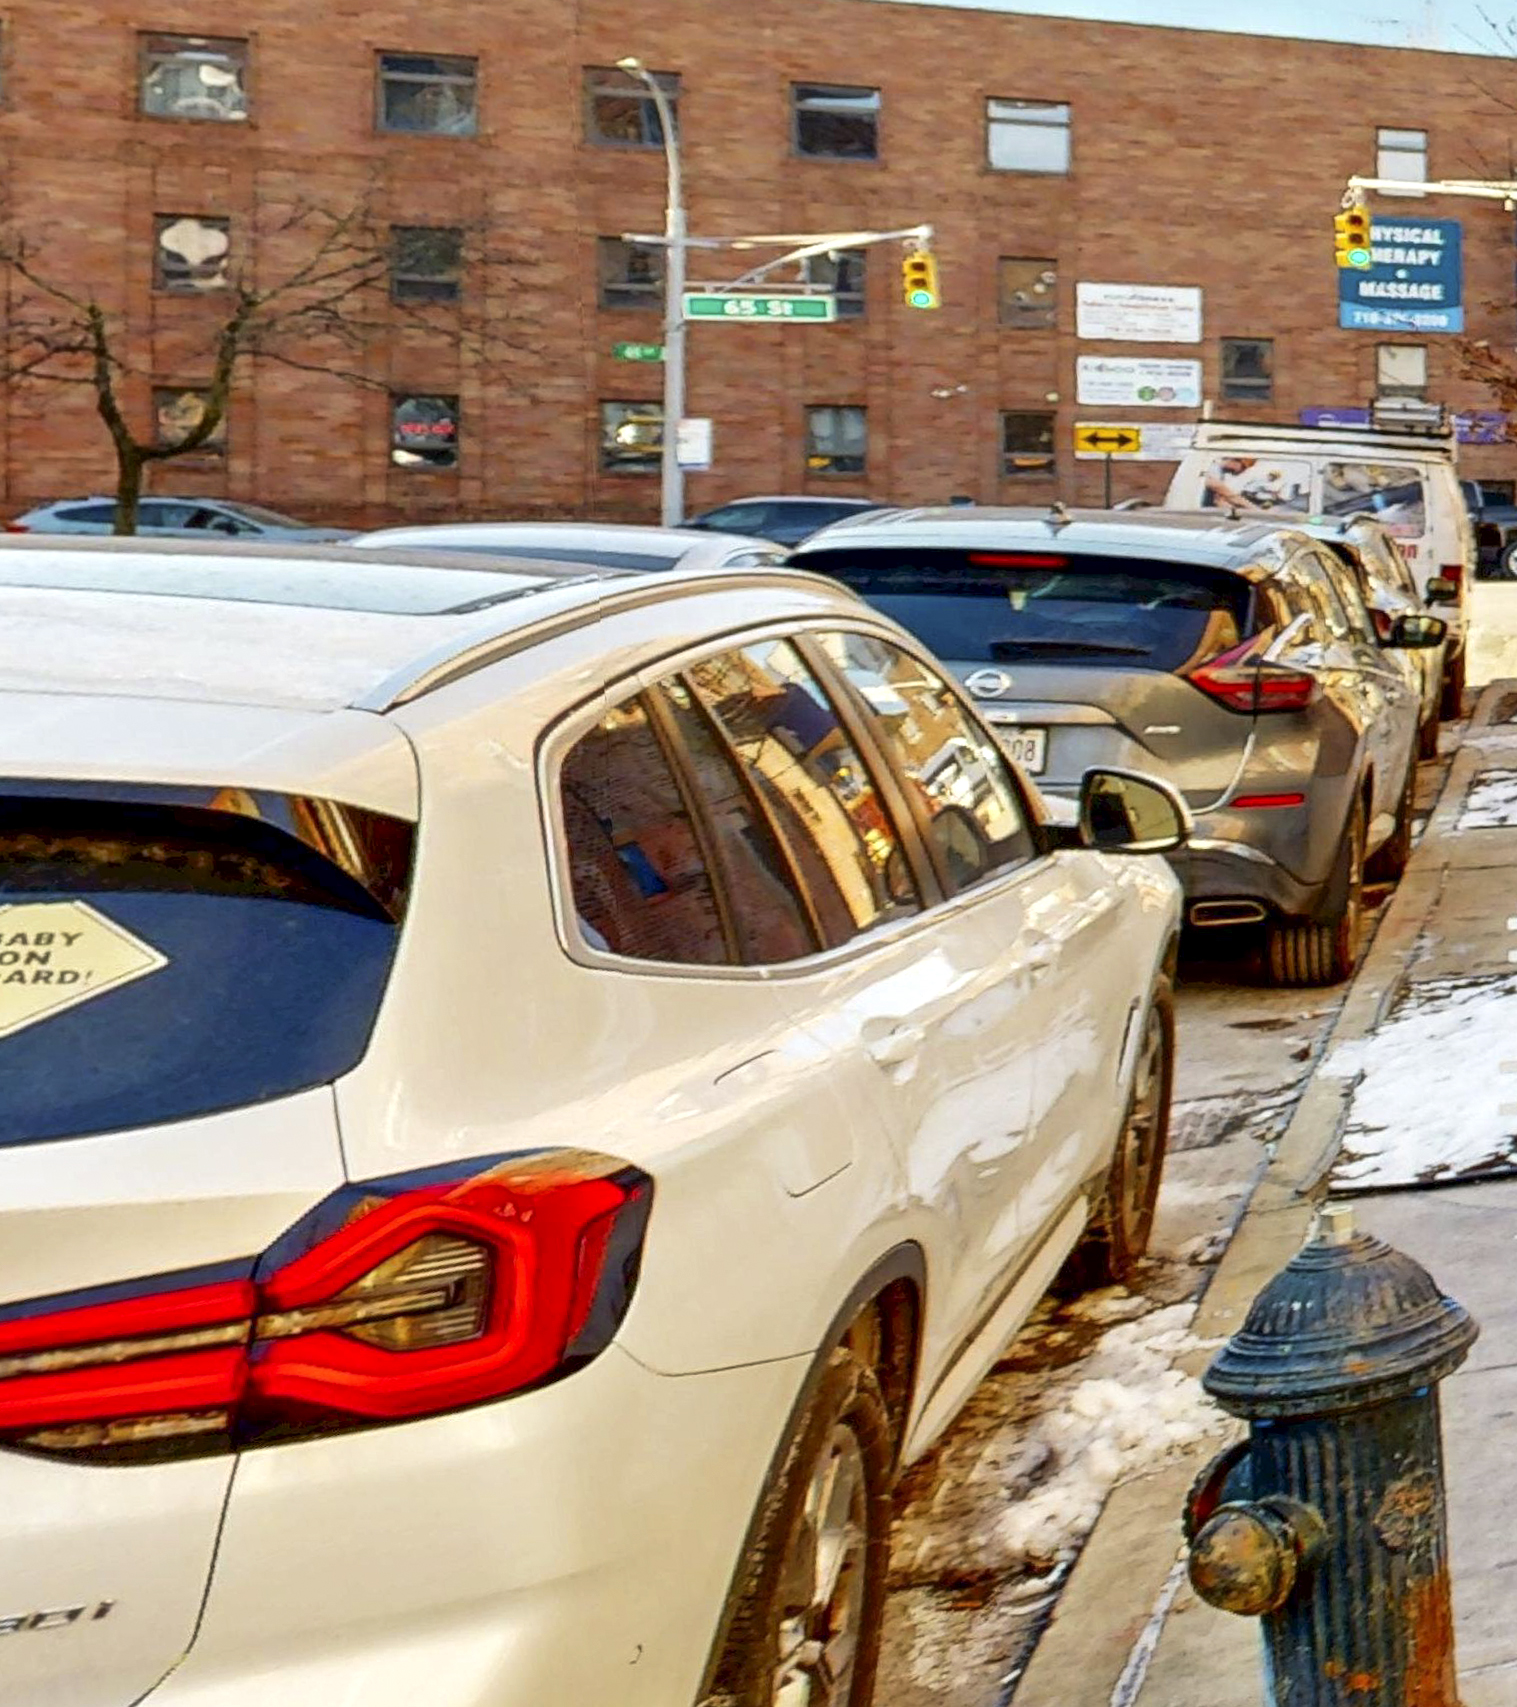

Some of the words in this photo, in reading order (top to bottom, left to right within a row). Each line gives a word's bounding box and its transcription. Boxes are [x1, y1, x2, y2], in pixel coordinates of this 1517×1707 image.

[1370, 225, 1446, 245] HYSICAL
[1371, 247, 1442, 266] HERAPY
[1358, 281, 1445, 301] MASSAGE
[723, 300, 757, 316] 65
[0, 951, 51, 965] ON
[0, 970, 93, 985] ARD!
